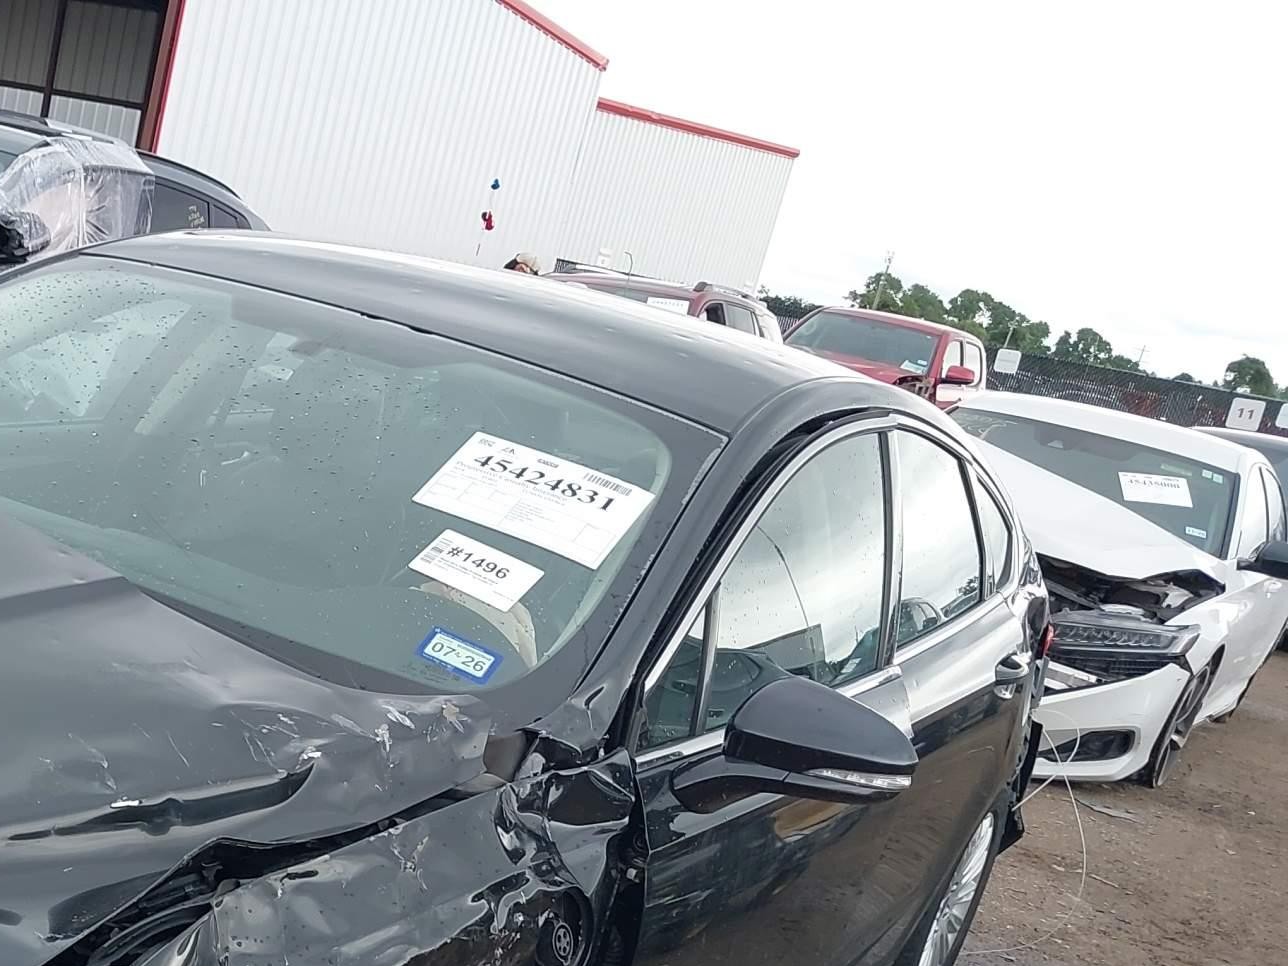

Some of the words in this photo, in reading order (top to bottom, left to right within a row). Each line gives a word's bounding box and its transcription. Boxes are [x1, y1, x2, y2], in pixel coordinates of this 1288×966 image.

[1237, 407, 1255, 420] 11
[474, 455, 616, 512] 45424831
[446, 546, 510, 580] #1496
[431, 641, 456, 657] 07
[461, 655, 486, 672] 26
